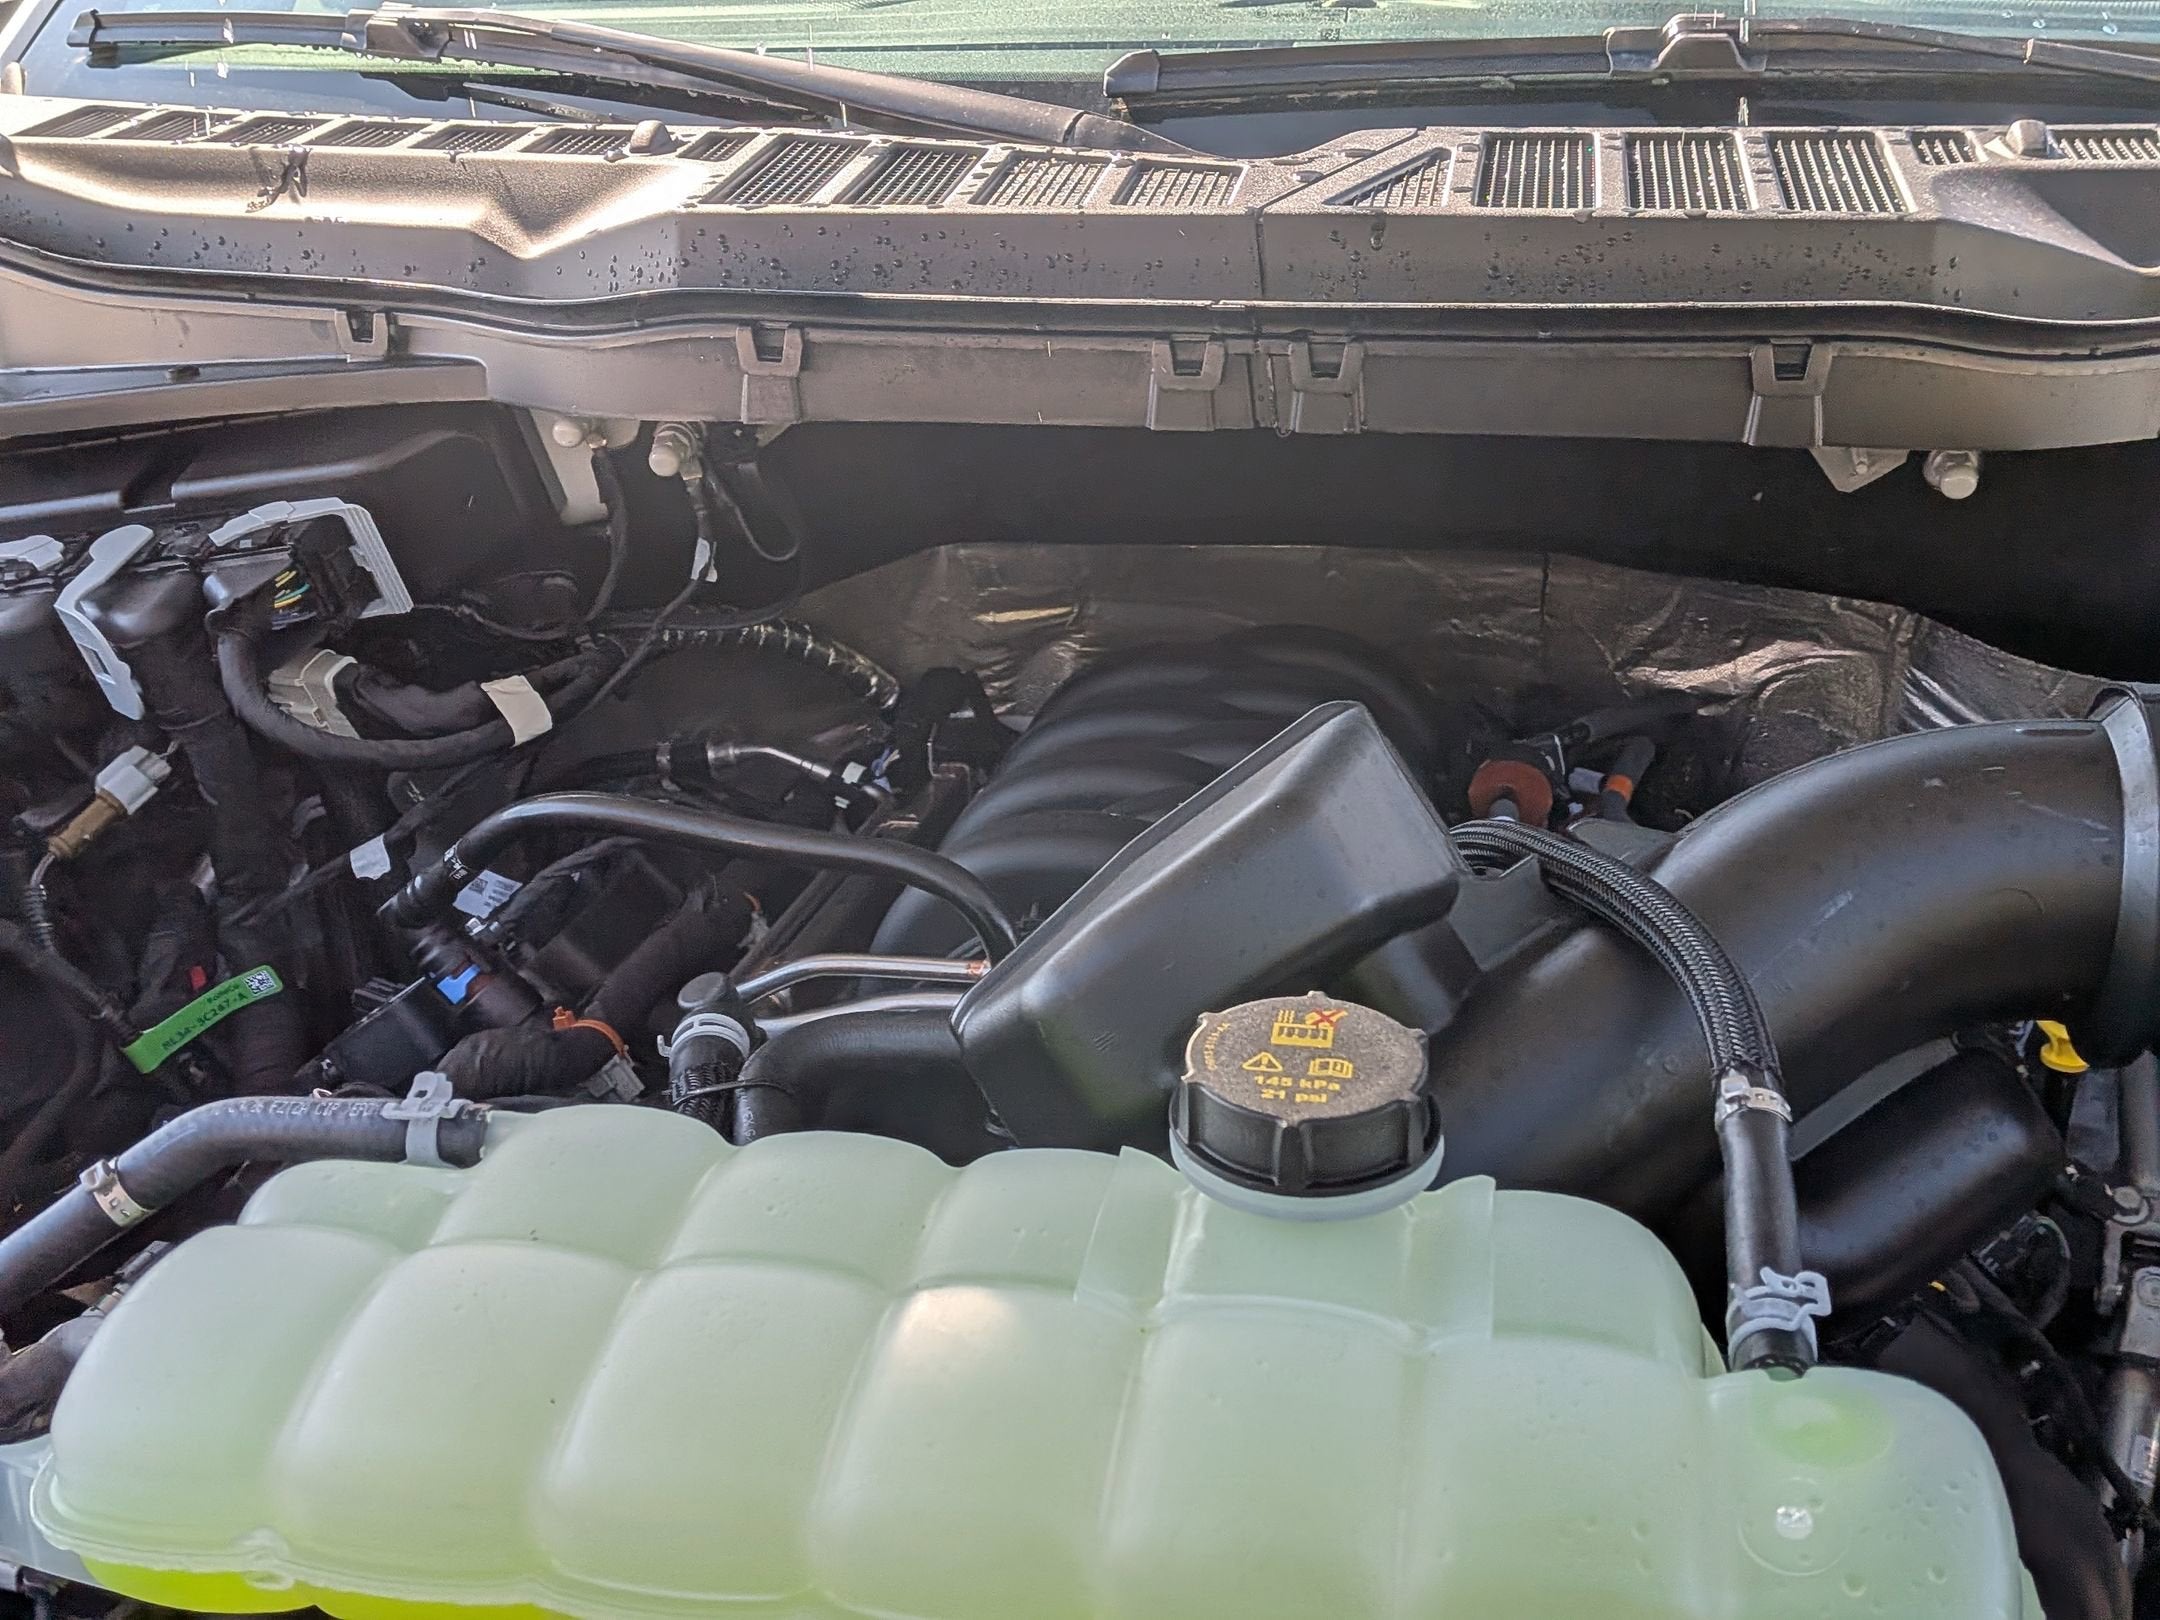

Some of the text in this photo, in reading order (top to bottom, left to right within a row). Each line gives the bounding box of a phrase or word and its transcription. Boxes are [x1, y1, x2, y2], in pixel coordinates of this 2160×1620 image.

[1254, 1075, 1341, 1091] 145 kPa
[1261, 1088, 1327, 1103] 21 psi
